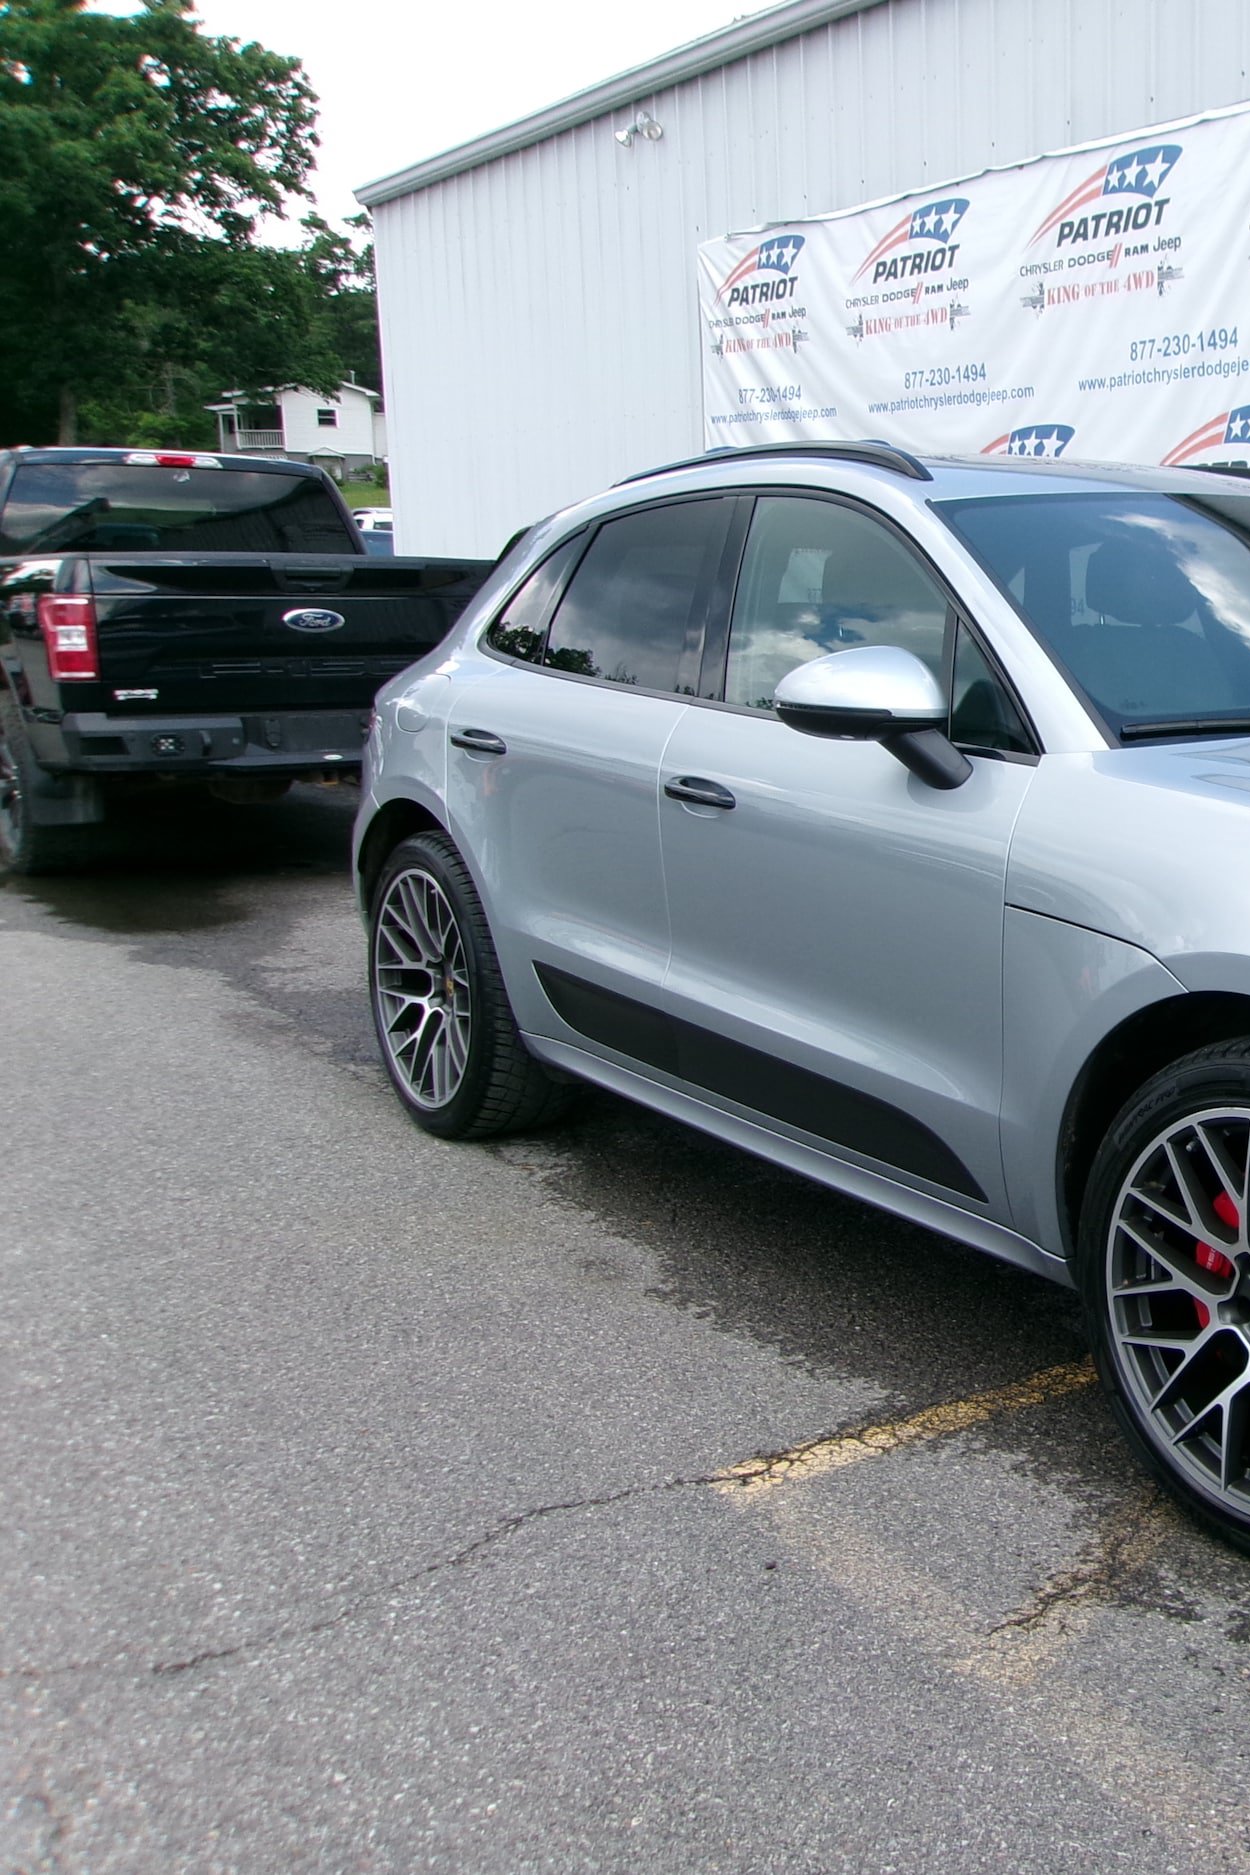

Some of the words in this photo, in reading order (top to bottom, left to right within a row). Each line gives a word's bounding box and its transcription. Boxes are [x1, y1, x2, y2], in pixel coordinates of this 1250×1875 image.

[1056, 197, 1171, 248] PATRIOT
[872, 243, 960, 285] PATRIOT
[1019, 259, 1064, 277] CHRYSLER
[1068, 250, 1114, 268] DODGE
[1124, 243, 1150, 258] RAM
[1153, 235, 1182, 253] Jeep
[727, 276, 799, 308] PATRIOT
[882, 287, 917, 303] DODGE
[924, 283, 944, 296] RAM
[946, 277, 969, 292] Jeep
[1047, 283, 1080, 306] KING
[1100, 279, 1120, 296] THE
[1123, 270, 1155, 292] 4WD
[771, 310, 787, 321] RAM
[788, 306, 807, 319] Jeep
[865, 316, 891, 336] KING
[1130, 326, 1239, 361] 877-230-1494
[904, 362, 987, 390] 877-230-1494
[868, 385, 1035, 414] www.patriotchryslerdodgejeep.com
